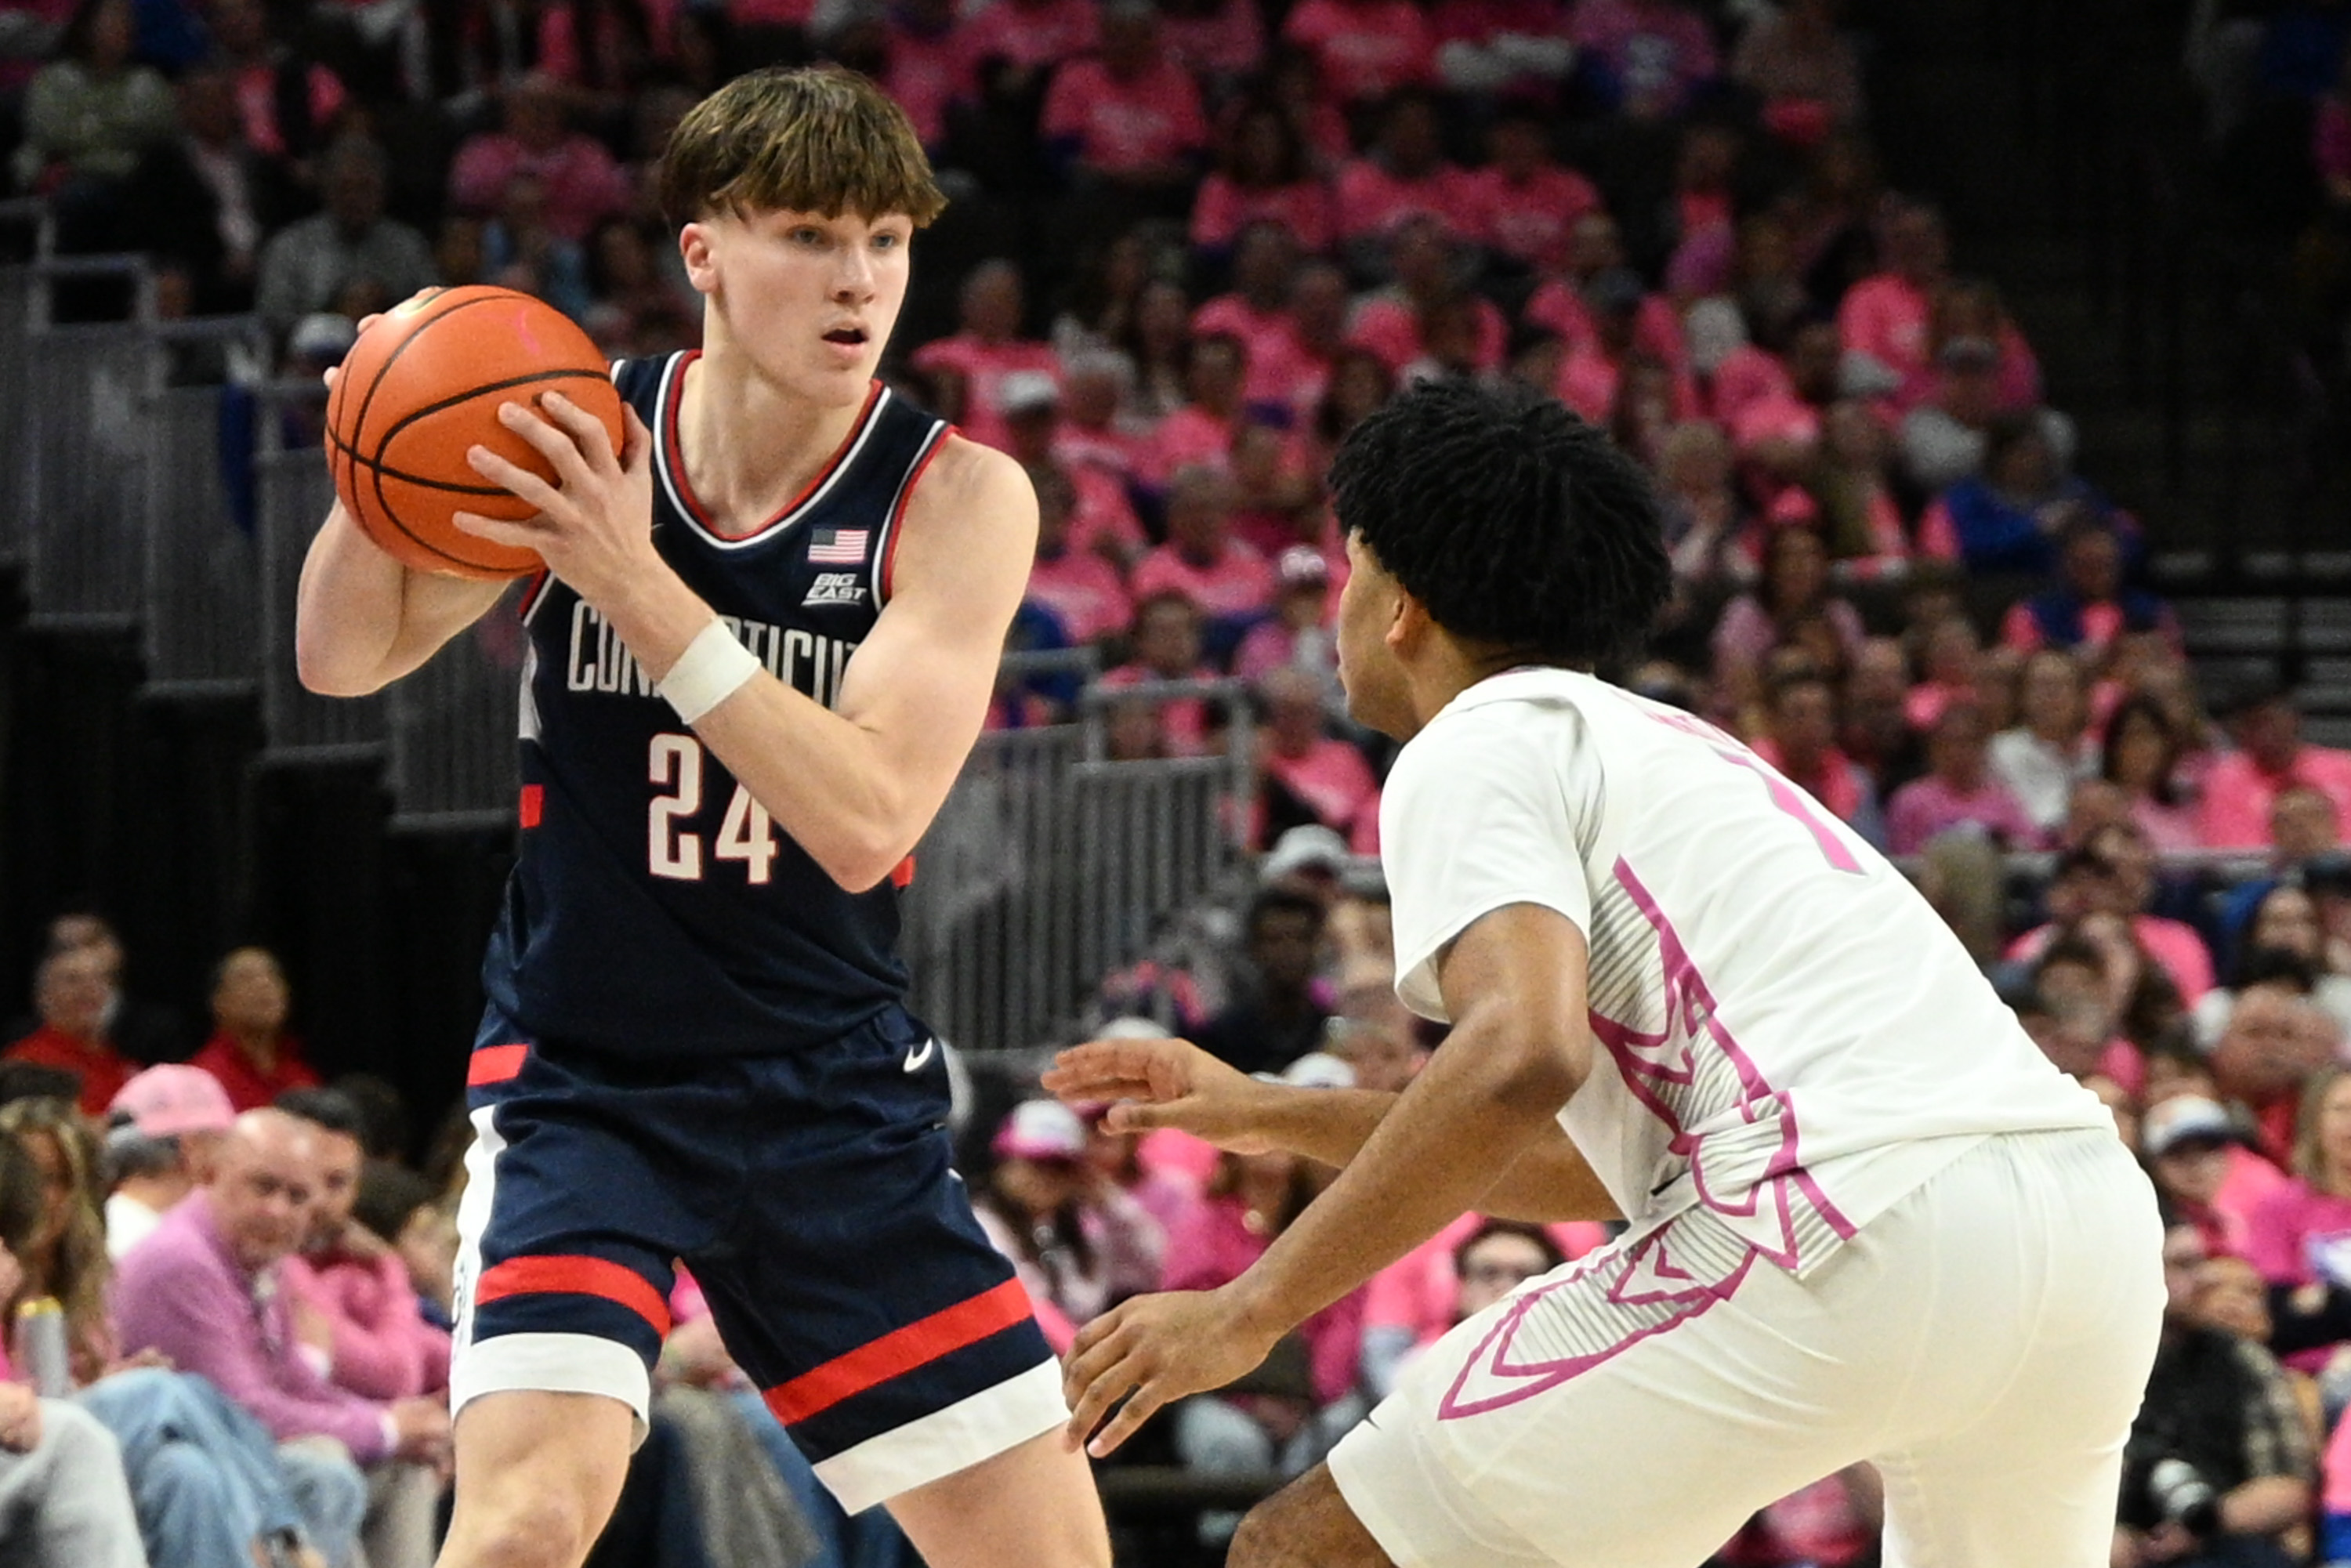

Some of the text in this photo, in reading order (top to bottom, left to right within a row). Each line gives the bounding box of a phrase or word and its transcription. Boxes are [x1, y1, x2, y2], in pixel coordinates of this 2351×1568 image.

[814, 574, 857, 587] BIG
[806, 586, 868, 599] EAST
[649, 731, 780, 885] 24
